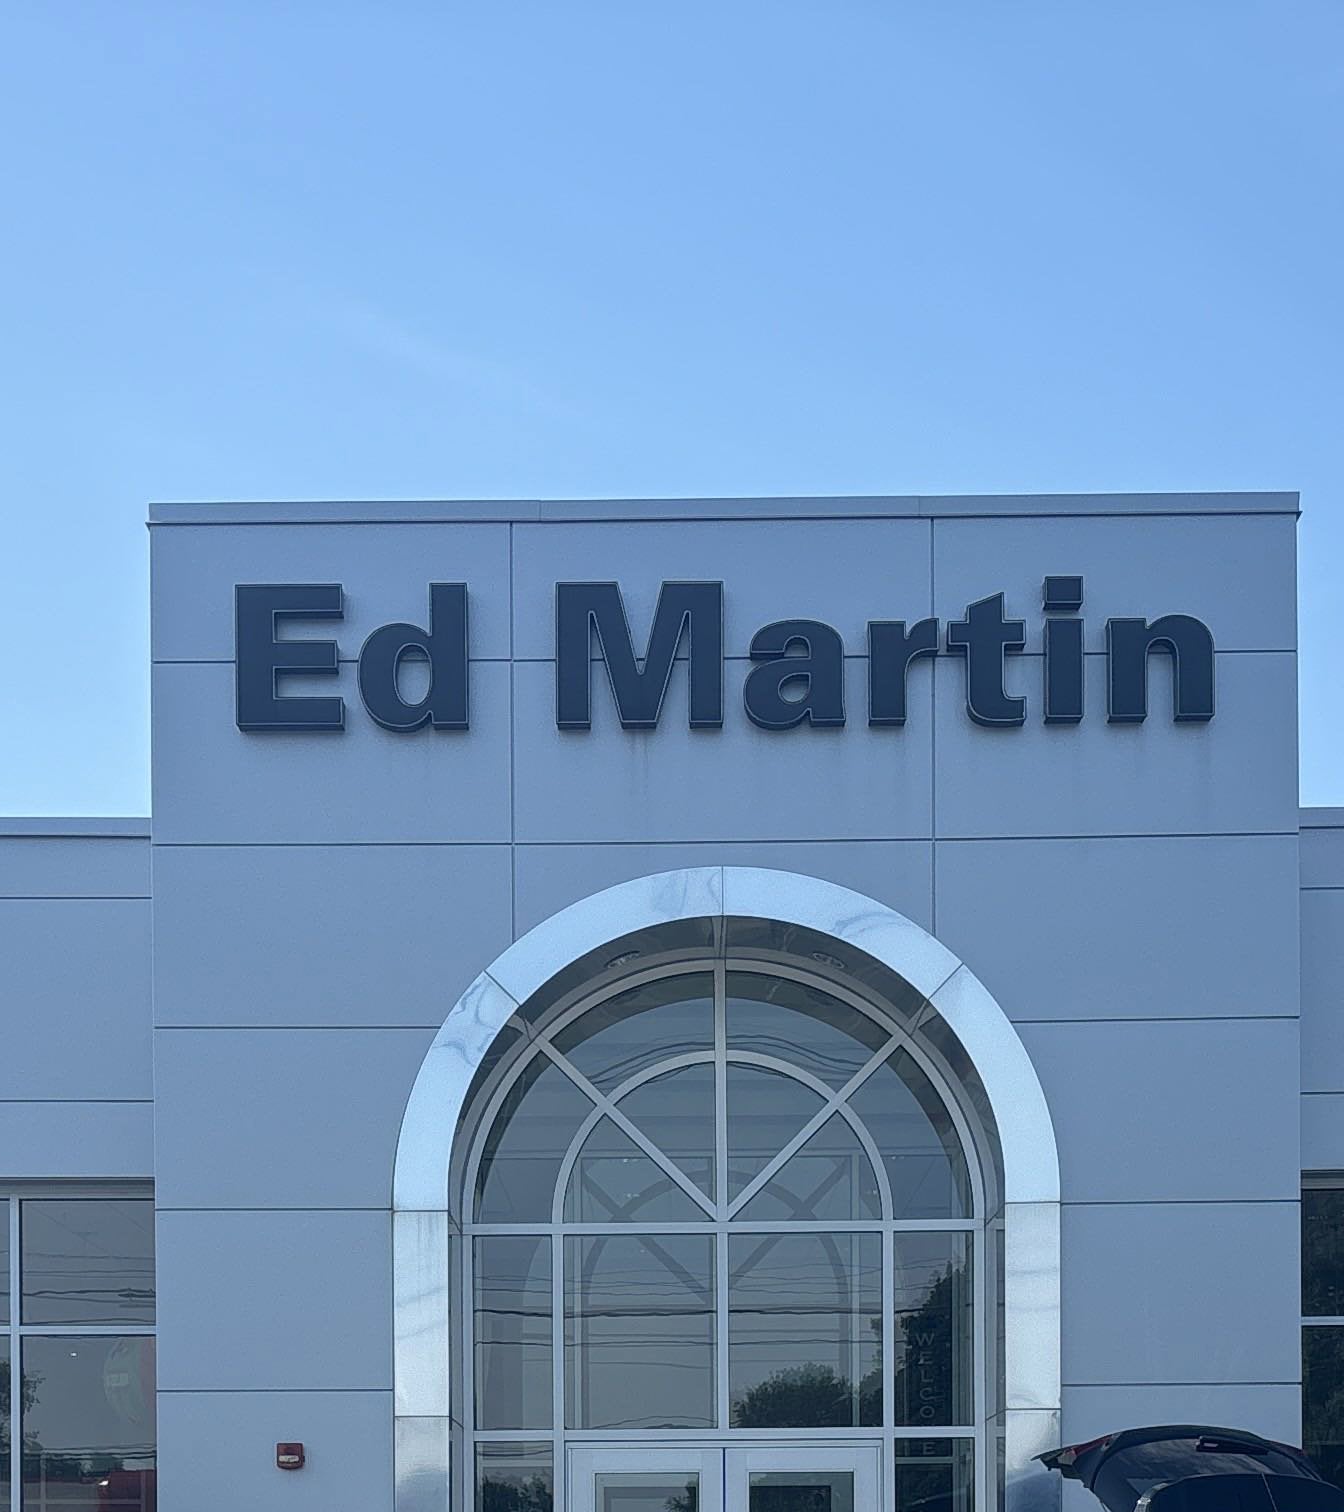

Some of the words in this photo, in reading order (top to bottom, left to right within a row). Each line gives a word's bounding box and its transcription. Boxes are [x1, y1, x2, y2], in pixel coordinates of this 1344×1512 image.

[234, 582, 470, 733] Ed
[554, 575, 1216, 731] Martin
[916, 1332, 937, 1456] WELCOE
